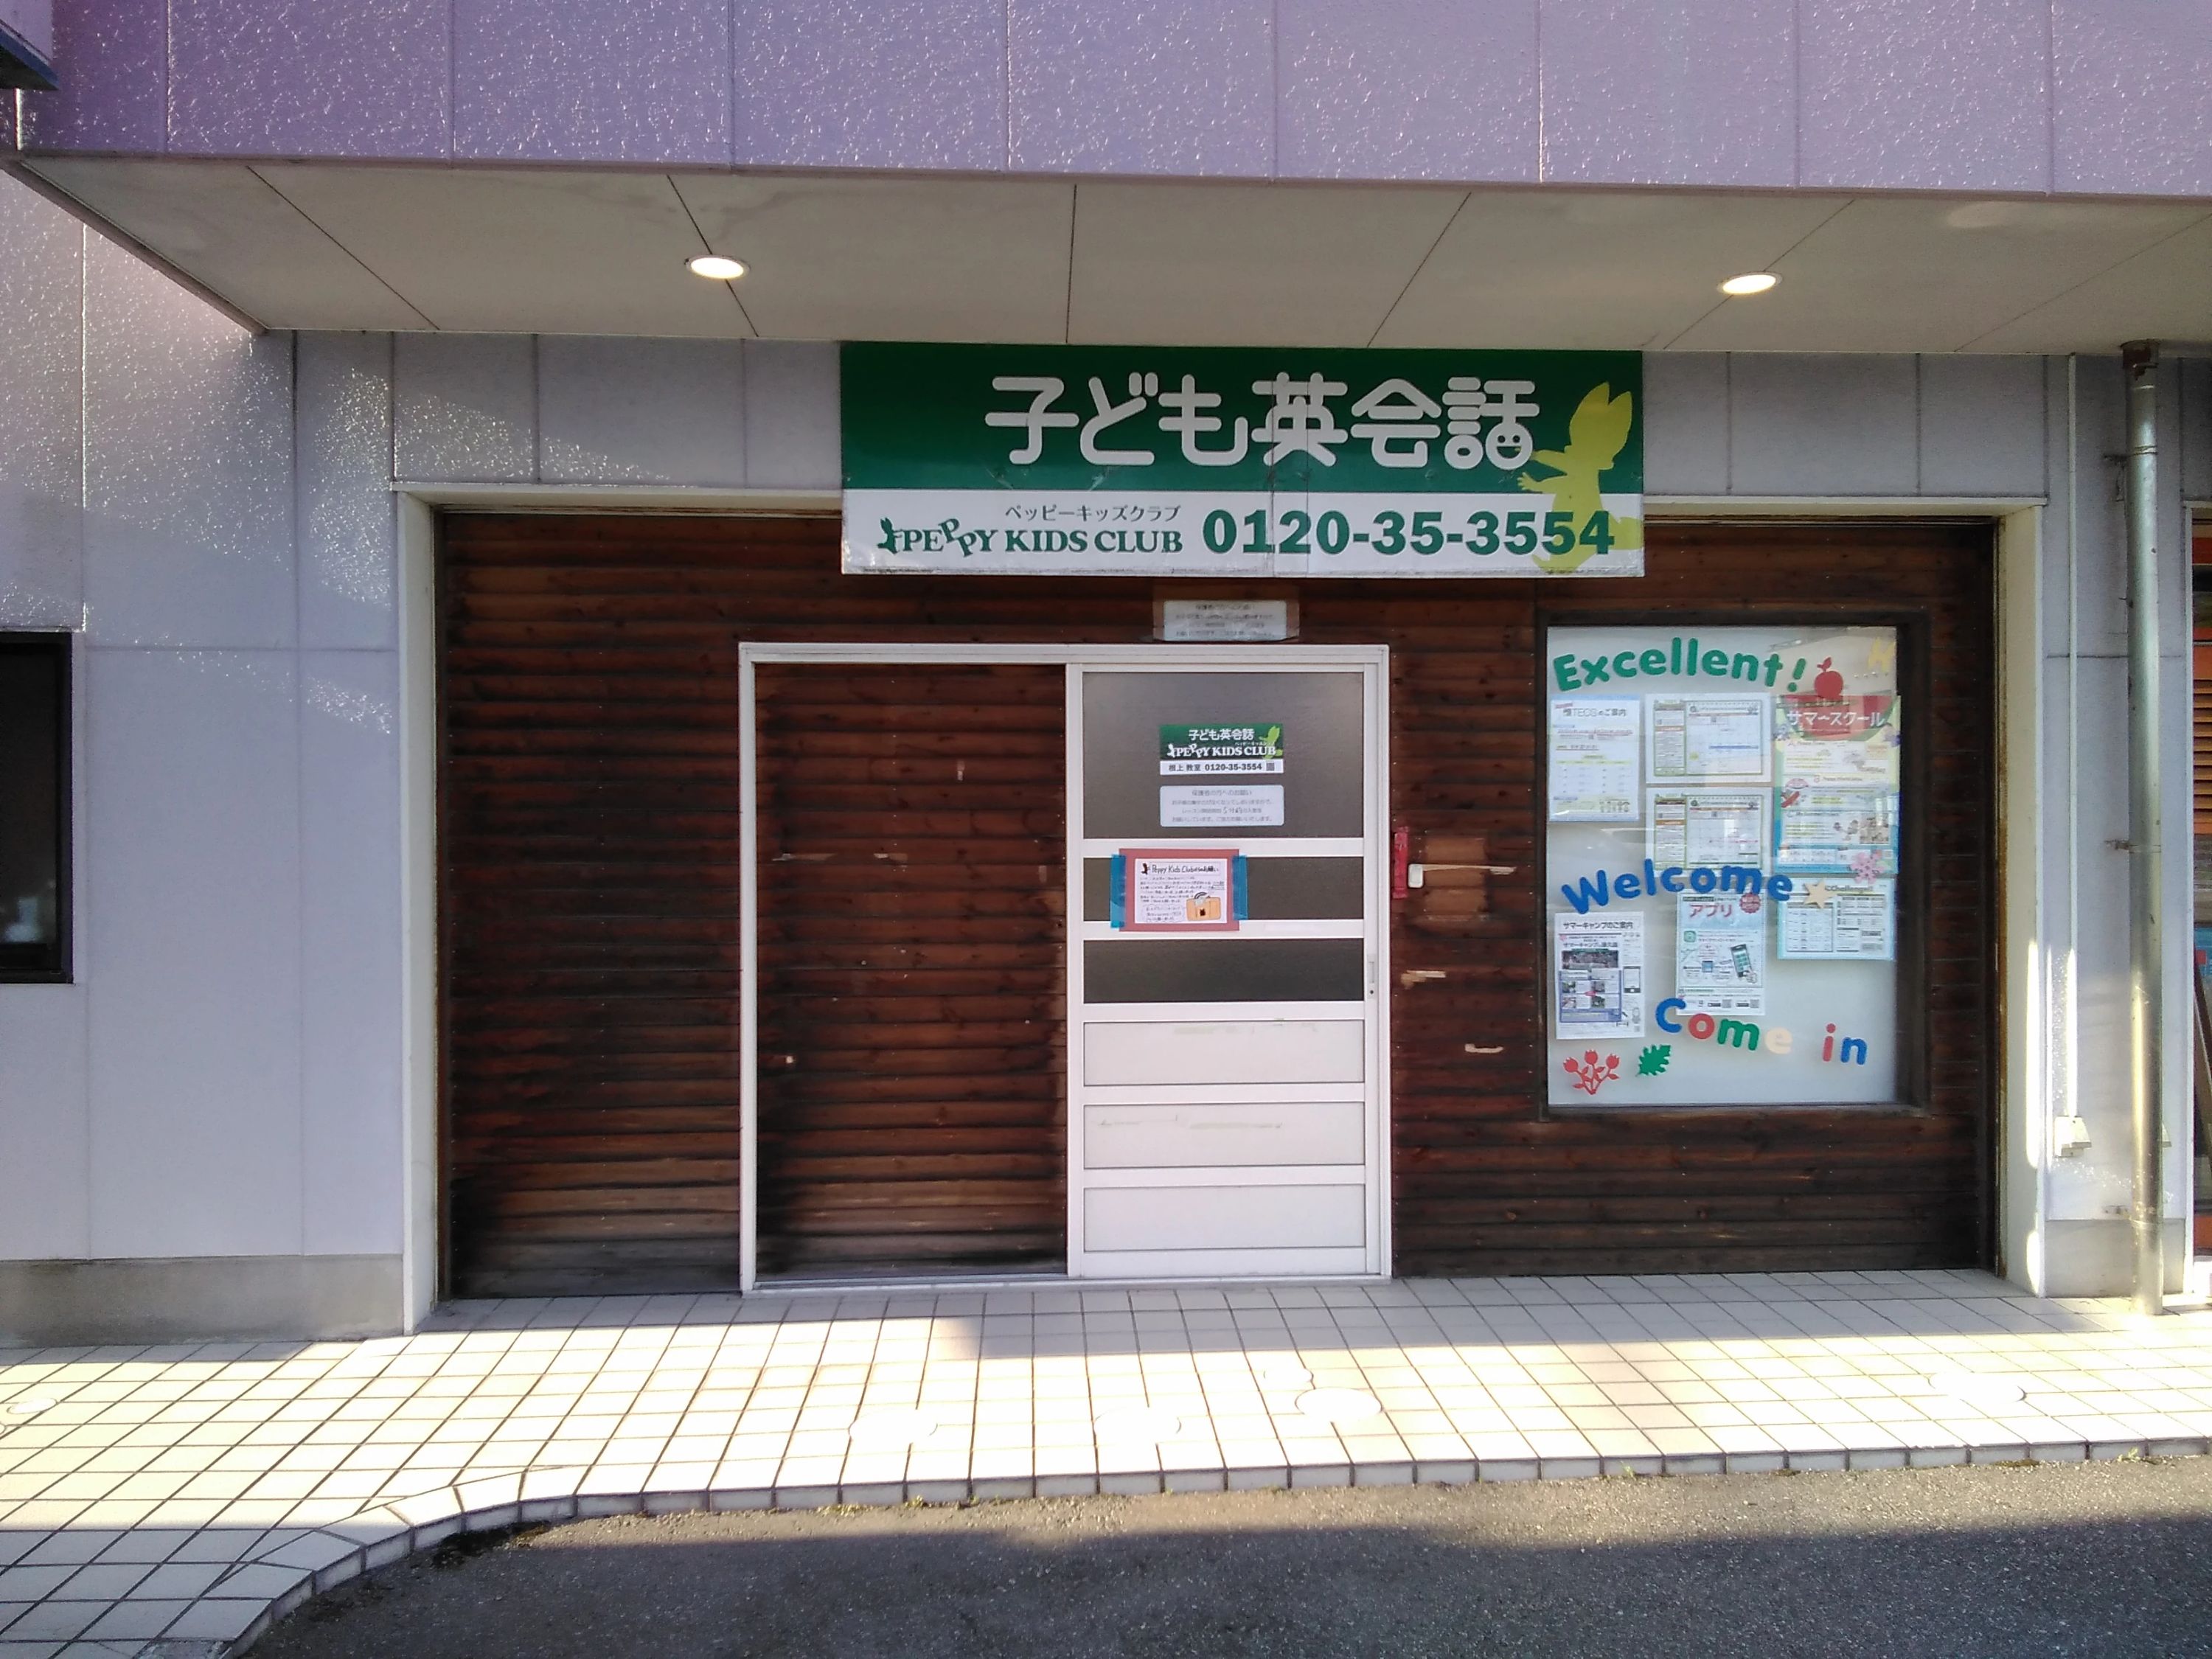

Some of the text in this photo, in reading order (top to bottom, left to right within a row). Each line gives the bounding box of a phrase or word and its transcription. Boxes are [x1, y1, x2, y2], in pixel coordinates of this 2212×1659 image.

[986, 372, 1540, 470] 子ども英会話
[1005, 504, 1183, 522] ペッピーキッズクラブ
[1203, 509, 1615, 556] 0120-35-3554
[903, 518, 1183, 557] PEPPY KIDS CLUB
[1553, 636, 1807, 692] Excellent!
[1189, 728, 1255, 741] 子ども英会話
[1787, 710, 1885, 726] サマースクール
[1175, 743, 1276, 758] PEPPY KIDS CLUB
[1205, 763, 1262, 771] 0120-35-3554
[1561, 858, 1793, 914] Welcome
[1655, 997, 1793, 1054] Come
[1821, 1023, 1868, 1065] in
